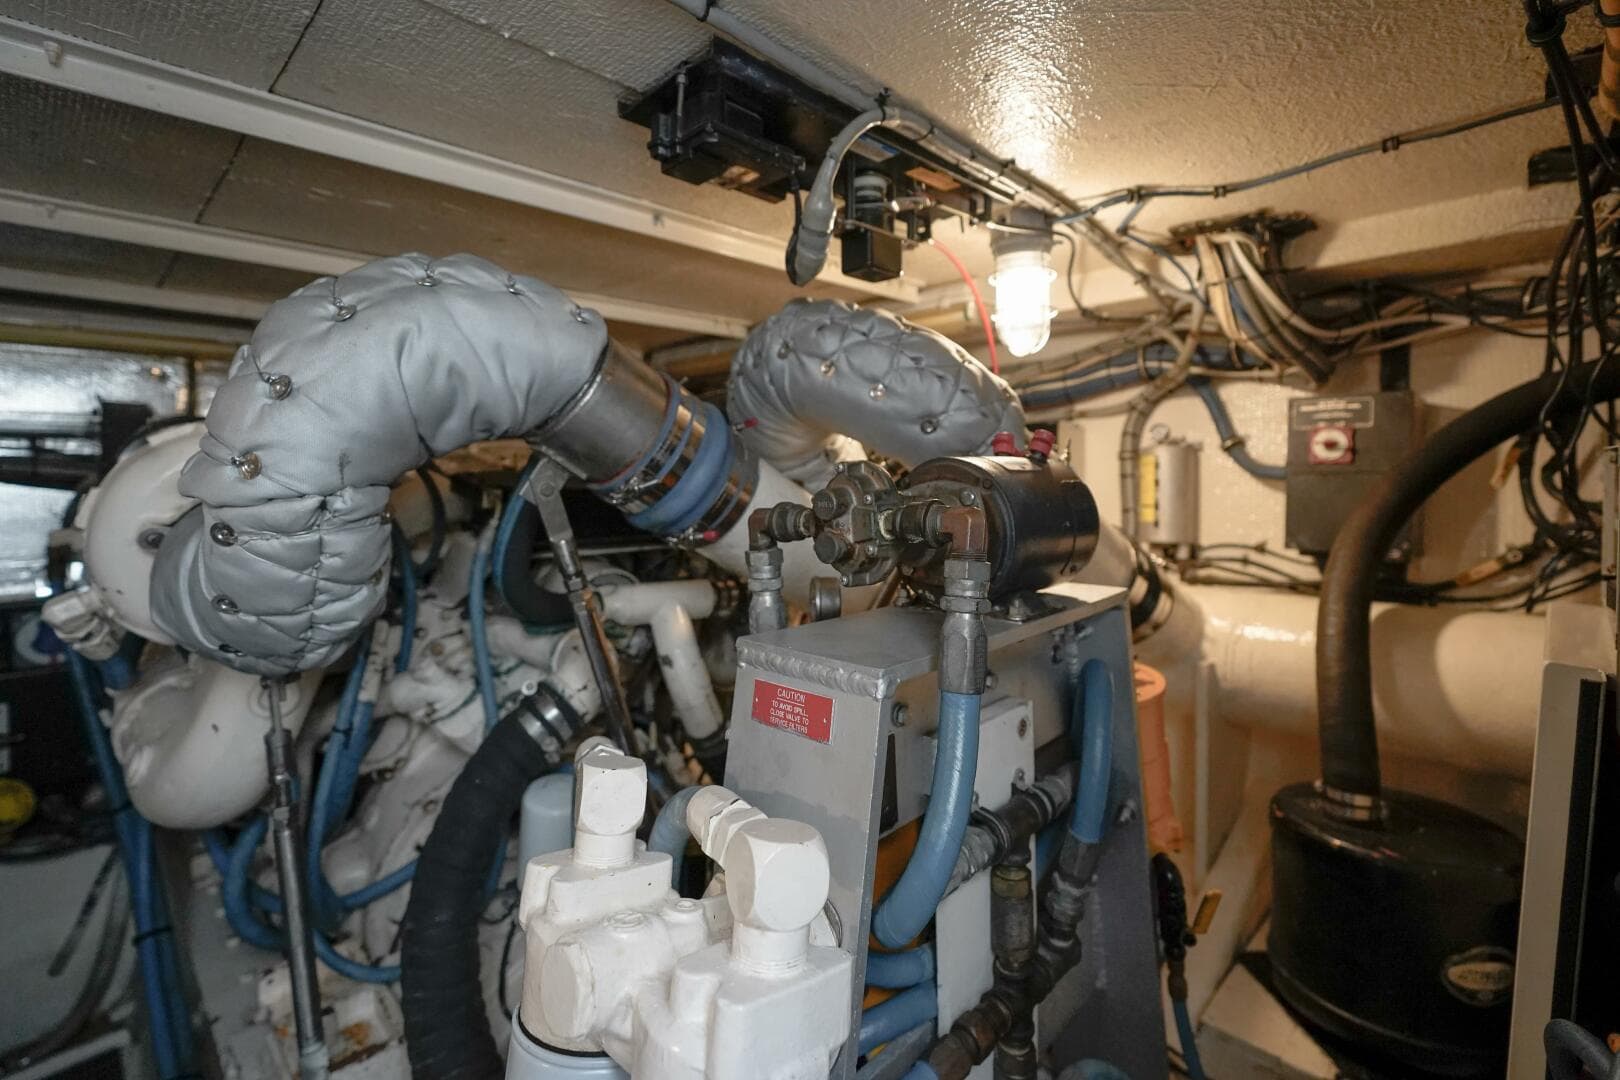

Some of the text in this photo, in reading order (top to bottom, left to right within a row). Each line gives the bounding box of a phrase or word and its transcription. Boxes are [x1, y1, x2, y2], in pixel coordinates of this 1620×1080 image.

[777, 688, 806, 703] CAUTION
[780, 702, 792, 712] AVOID
[770, 708, 808, 726] CLOSE VALVE TO
